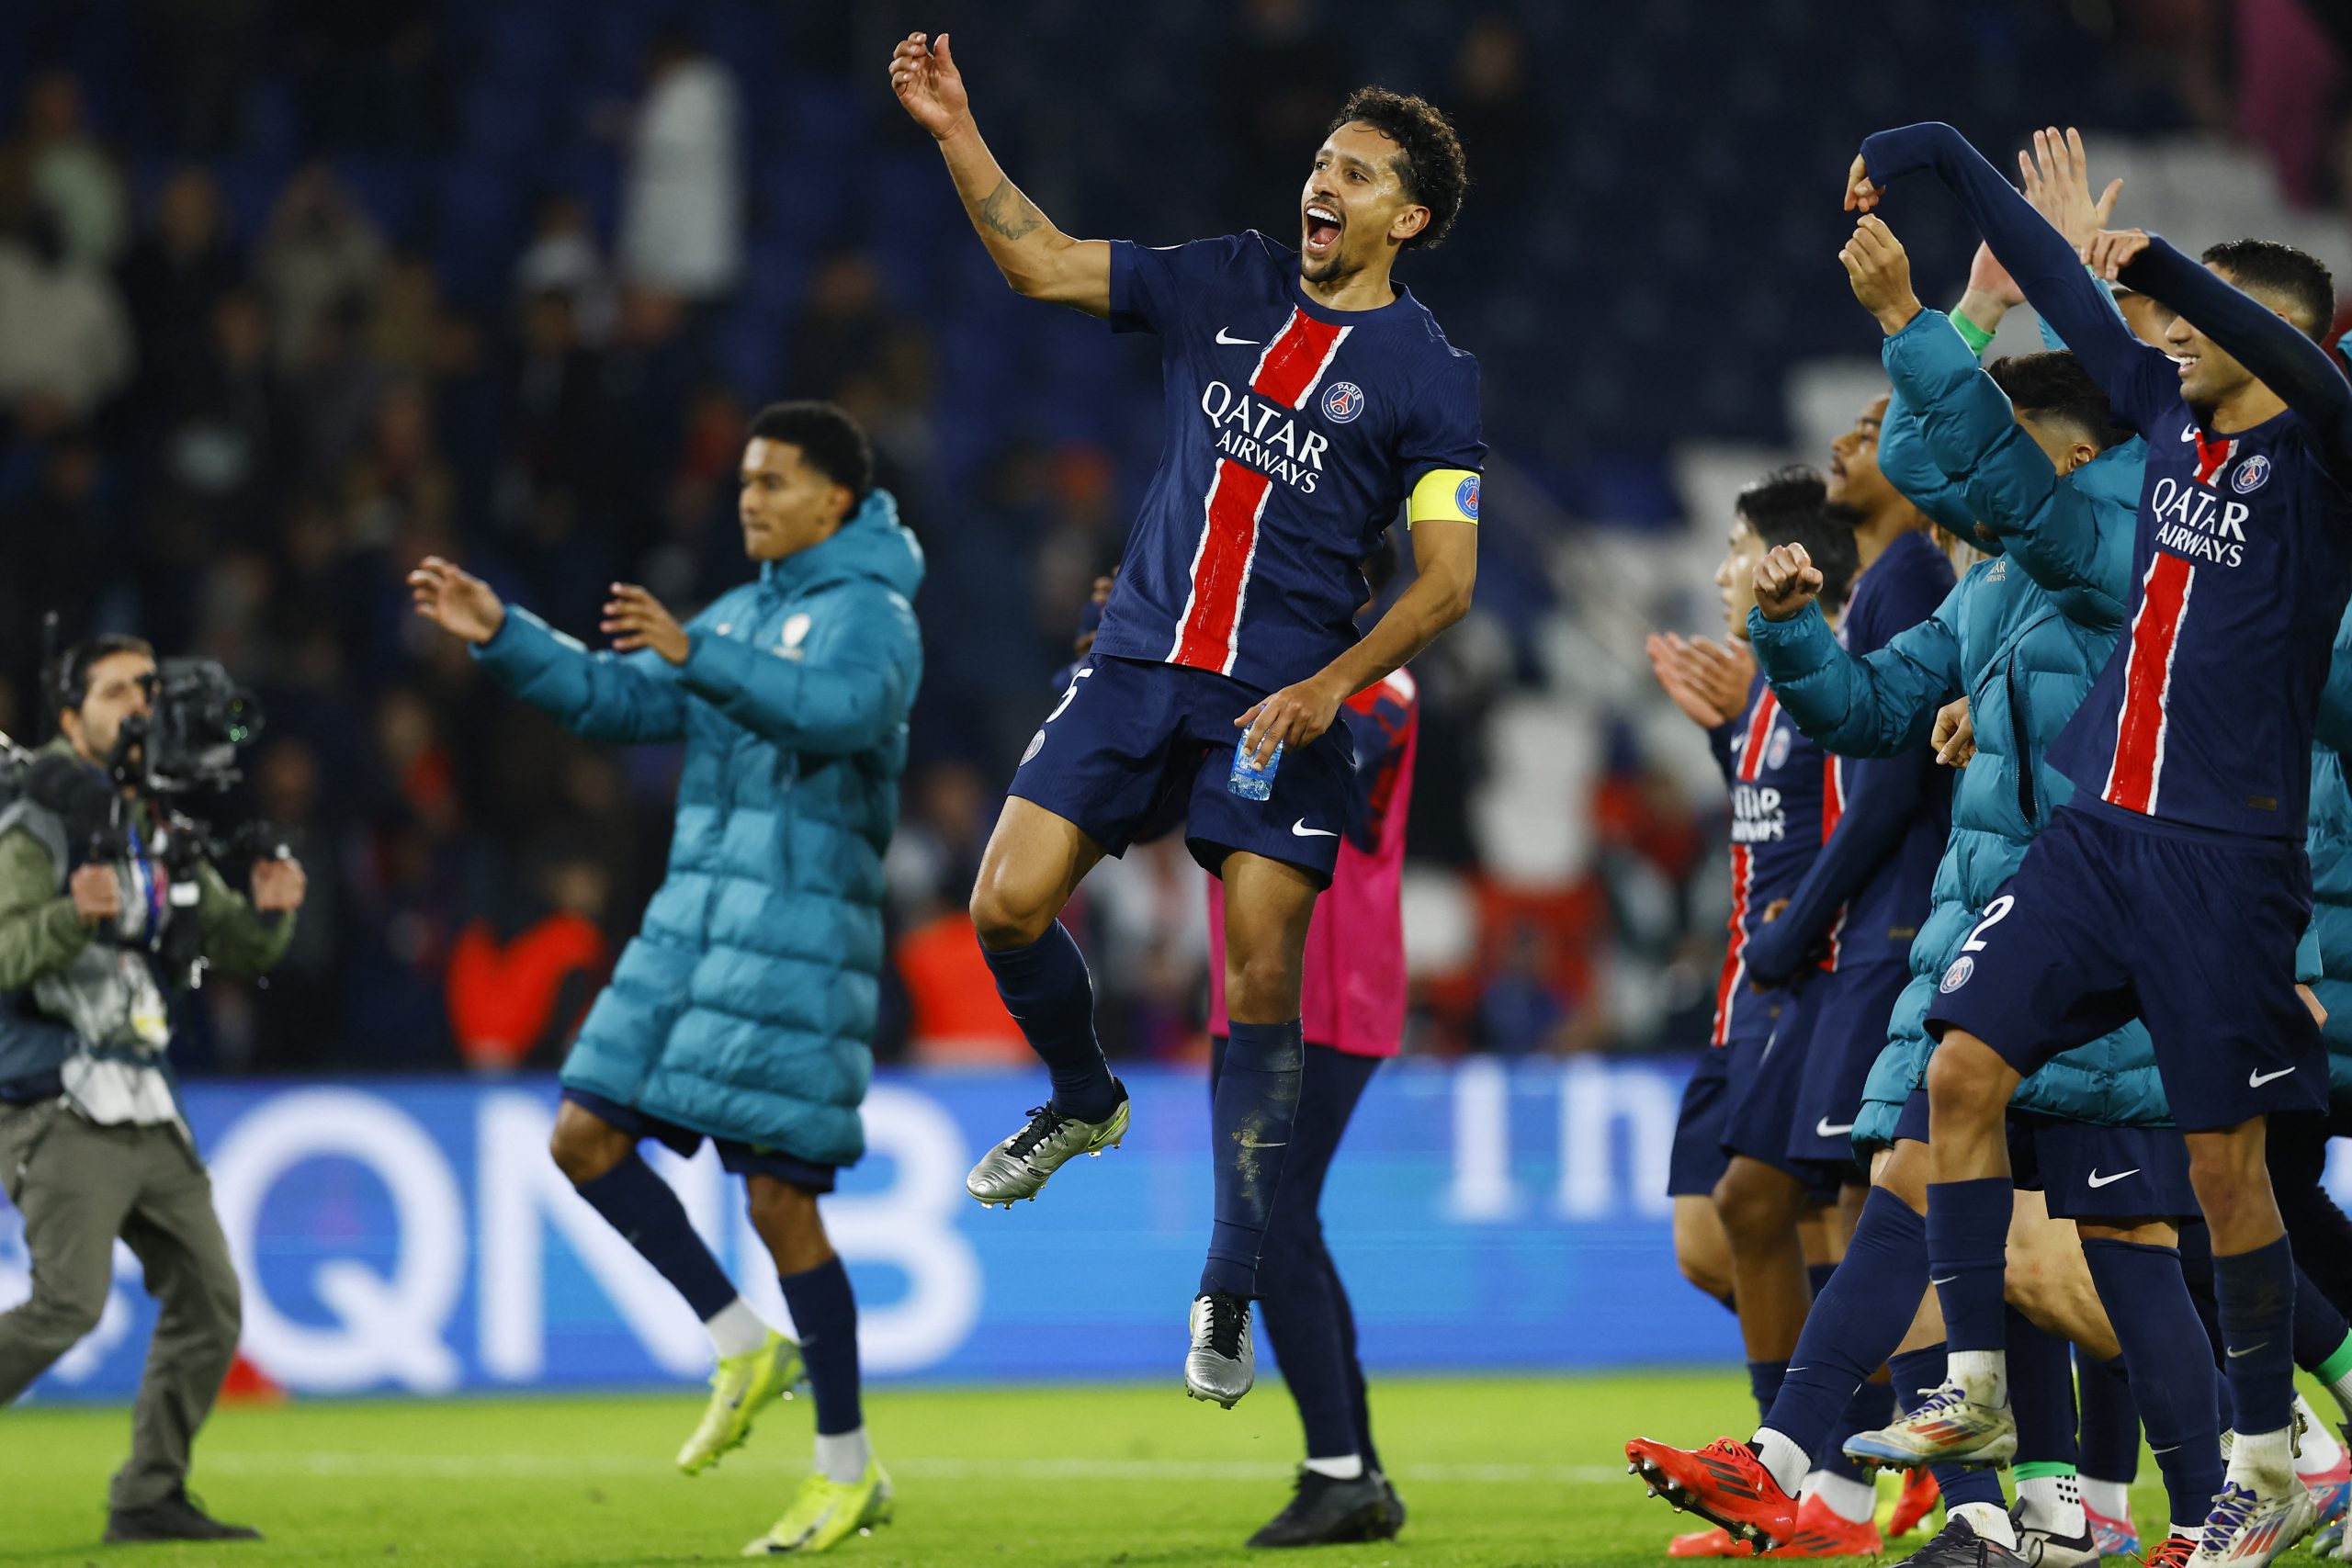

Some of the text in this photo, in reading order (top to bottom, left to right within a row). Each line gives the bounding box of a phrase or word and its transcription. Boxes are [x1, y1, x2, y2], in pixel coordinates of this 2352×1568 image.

[1338, 384, 1362, 400] PARIS
[1202, 381, 1329, 470] QATAR
[1216, 430, 1319, 493] AIRWAYS
[2152, 477, 2249, 542] QATAR
[2155, 521, 2244, 568] AIRWAYS
[1046, 668, 1094, 723] 5
[1962, 895, 2015, 952] 2
[211, 1087, 983, 1393] QNB
